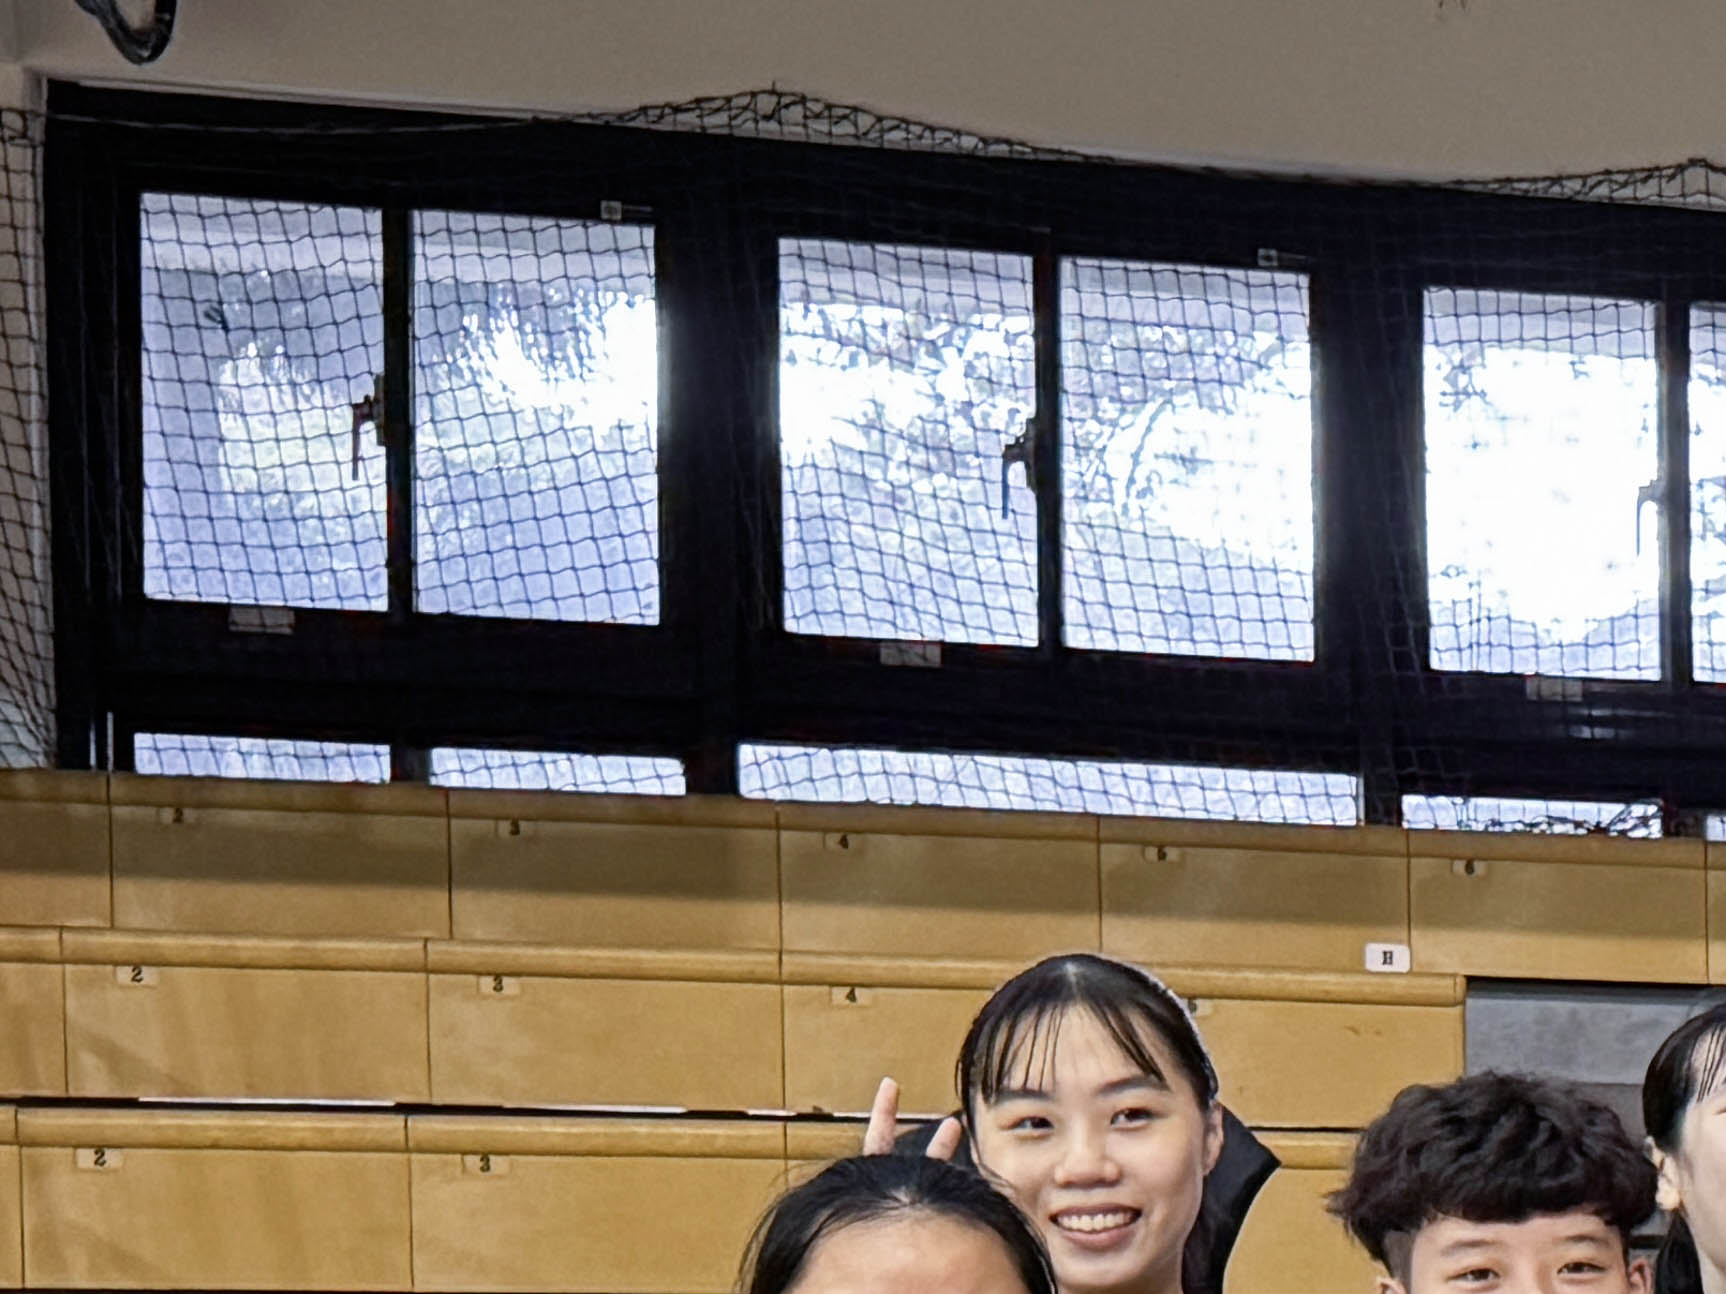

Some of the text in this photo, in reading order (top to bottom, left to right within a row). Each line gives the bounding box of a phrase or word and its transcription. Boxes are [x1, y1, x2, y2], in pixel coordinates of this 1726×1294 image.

[510, 820, 520, 835] 3
[839, 835, 849, 849] 4
[131, 966, 143, 983] 2
[493, 976, 503, 992] 3
[846, 987, 857, 1002] 4
[94, 1149, 106, 1167] 2
[480, 1156, 491, 1173] 3
